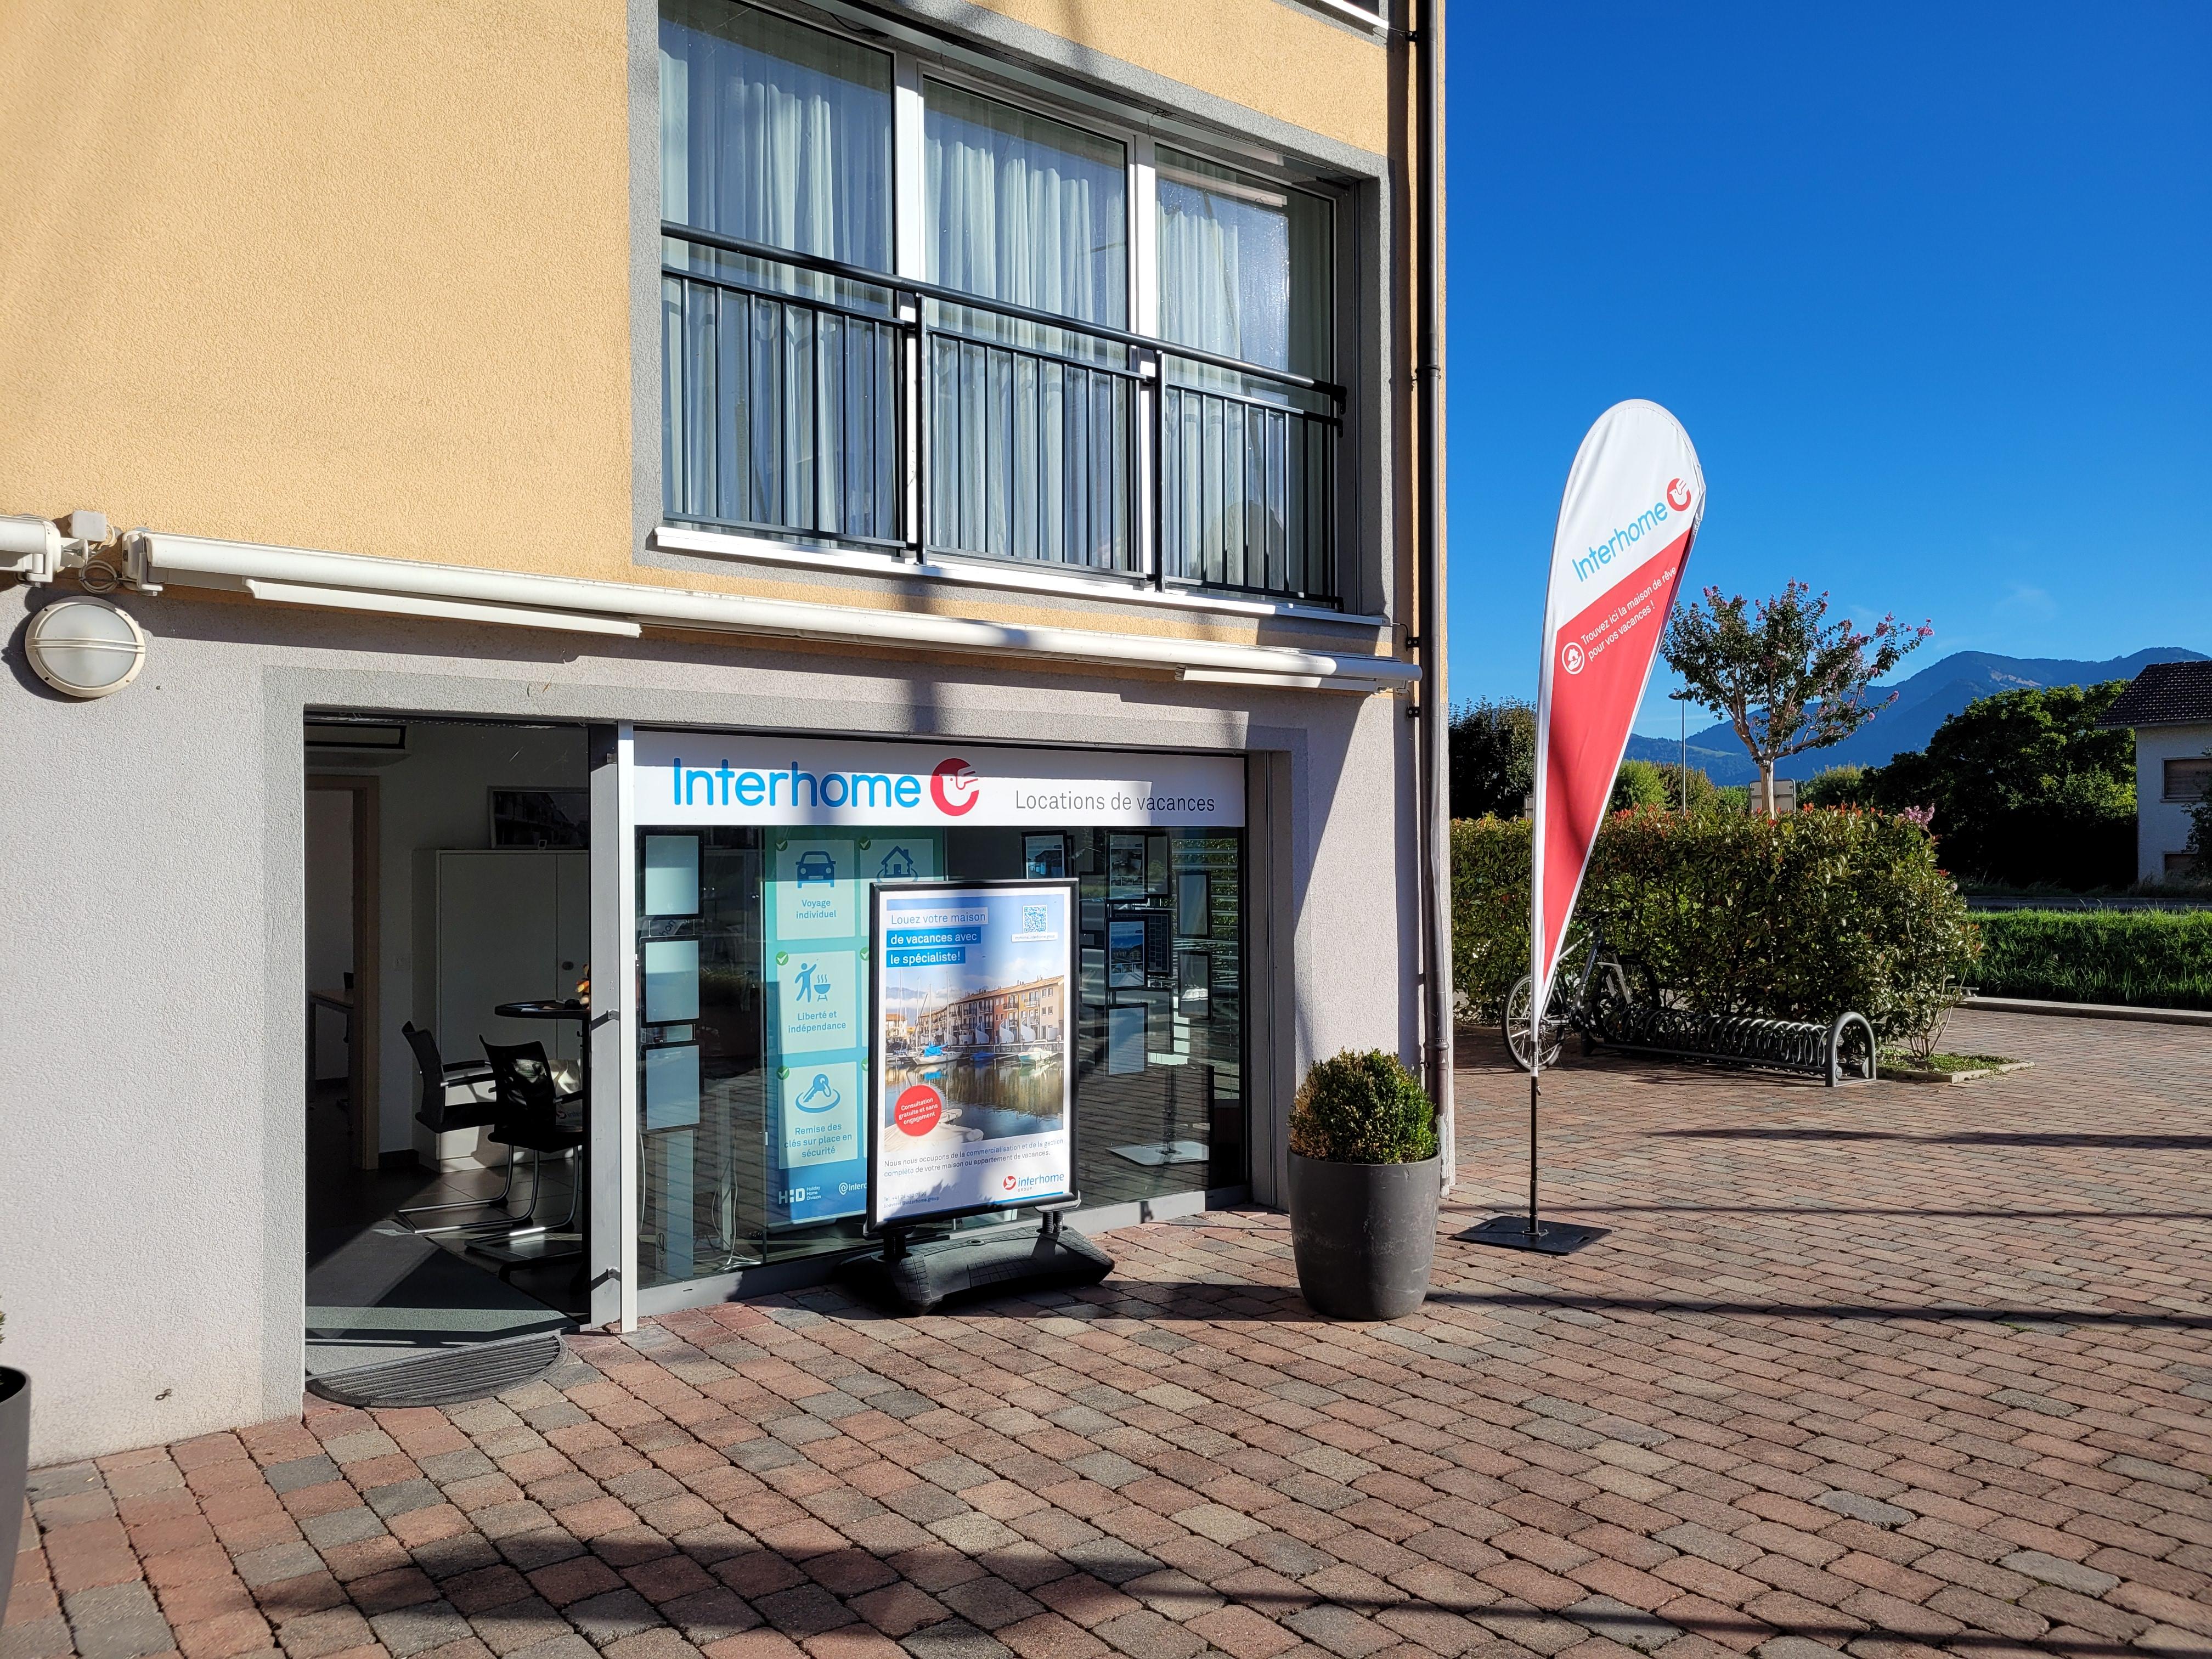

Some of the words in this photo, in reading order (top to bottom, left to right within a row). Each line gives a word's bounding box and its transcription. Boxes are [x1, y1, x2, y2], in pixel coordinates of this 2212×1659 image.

[1572, 502, 1668, 582] Interhome
[1581, 619, 1610, 645] Trouvez
[1608, 610, 1619, 624] ici
[1617, 606, 1628, 617] la
[1627, 586, 1653, 611] maison
[1652, 579, 1662, 590] de
[1662, 567, 1676, 583] rêve
[1588, 641, 1605, 662] pour
[1605, 631, 1618, 646] vos
[1618, 604, 1651, 634] vacances
[673, 757, 921, 808] Interhome
[1015, 790, 1105, 810] Locations
[1111, 792, 1132, 810] de
[1137, 794, 1215, 812] vacances
[802, 899, 831, 909] Voyage
[796, 910, 836, 919] individuel
[891, 915, 920, 924] Louez
[923, 913, 948, 923] votre
[951, 912, 985, 922] maison
[890, 934, 904, 945] de
[906, 934, 952, 944] vacances
[955, 933, 977, 941] avec
[890, 954, 900, 964] le
[902, 951, 960, 966] spécialiste!
[798, 1011, 827, 1020] Liberté
[788, 1023, 847, 1034] indépendance
[901, 1098, 934, 1111] Consultation
[899, 1109, 919, 1120] gratuite
[903, 1111, 936, 1125] engagement
[795, 1125, 825, 1135] Remise
[784, 1139, 801, 1148] clés
[819, 1135, 840, 1146] place
[802, 1146, 836, 1158] sécurité
[919, 1154, 949, 1163] occupons
[967, 1144, 1020, 1156] commercialisation
[1044, 1138, 1063, 1148] gestion
[884, 1167, 914, 1177] complète
[942, 1161, 964, 1170] maison
[973, 1155, 1012, 1166] appartement
[1022, 1150, 1051, 1159] vacances.
[1018, 1173, 1064, 1187] interhome
